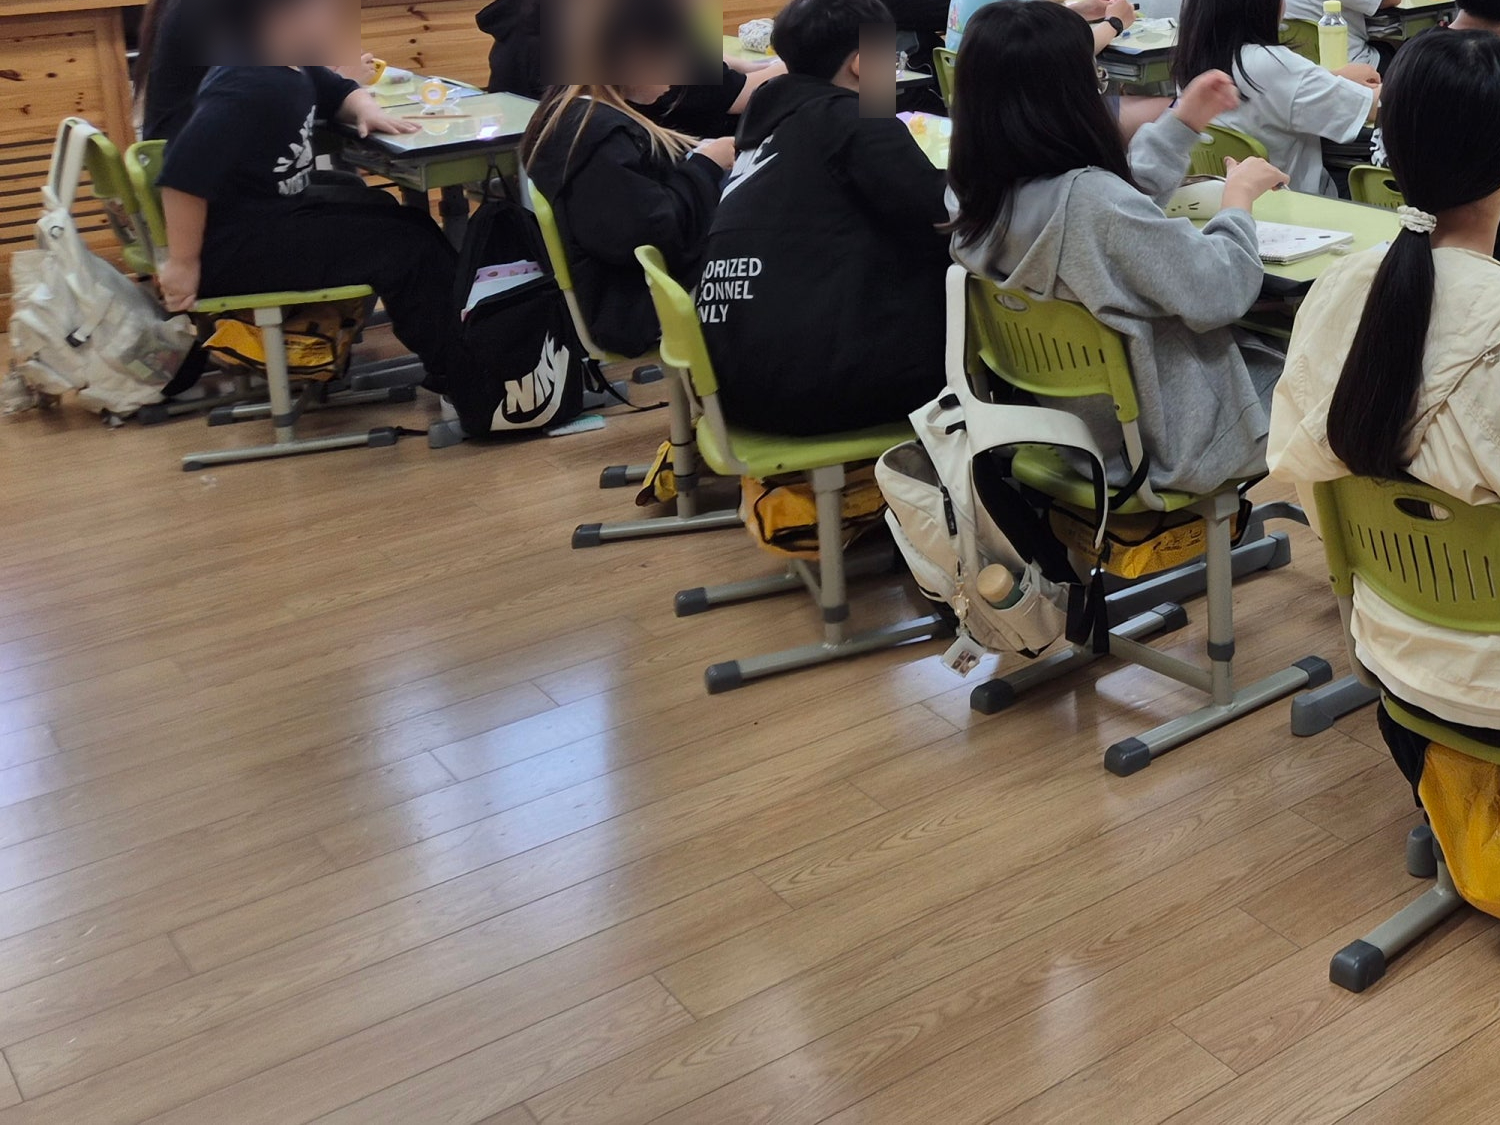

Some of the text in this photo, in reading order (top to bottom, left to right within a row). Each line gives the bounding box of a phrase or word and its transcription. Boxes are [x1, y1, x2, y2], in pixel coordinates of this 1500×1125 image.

[702, 257, 762, 279] ORIZED
[700, 280, 754, 302] ONNEL
[698, 304, 729, 323] NLY
